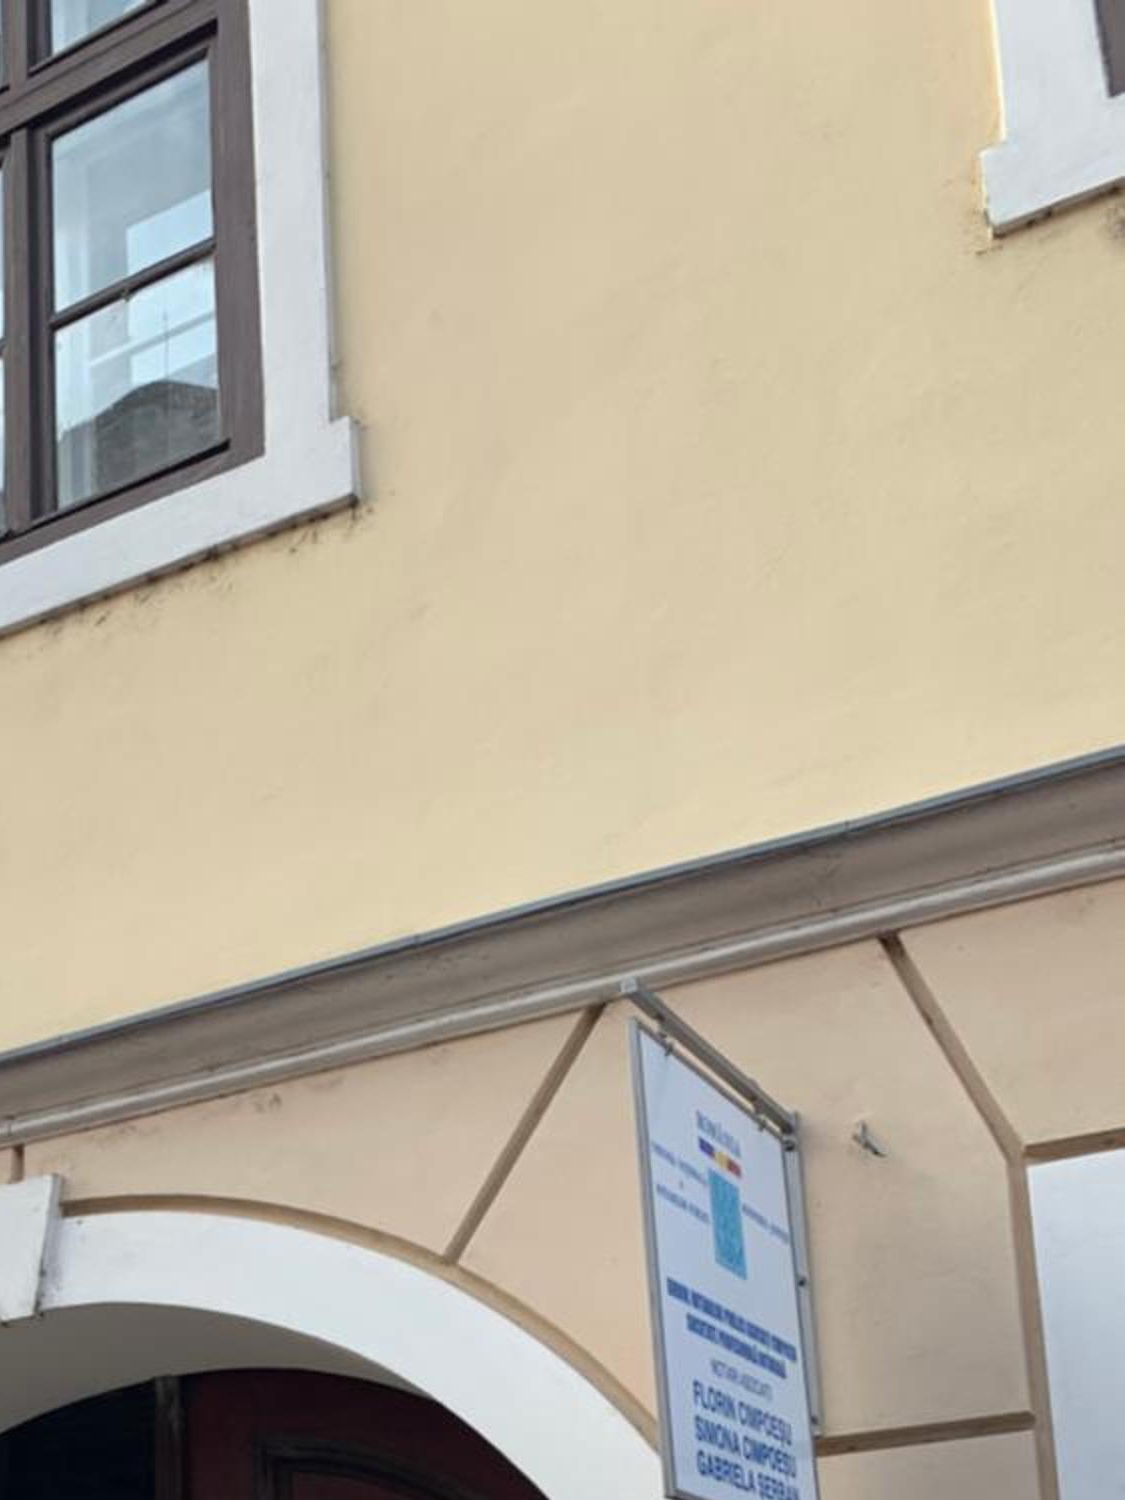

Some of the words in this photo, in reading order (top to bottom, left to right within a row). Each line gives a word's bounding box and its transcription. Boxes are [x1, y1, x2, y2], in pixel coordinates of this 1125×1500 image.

[693, 1379, 736, 1420] FLORIN
[695, 1415, 740, 1454] SIMONA
[697, 1449, 756, 1492] GABRIELA
